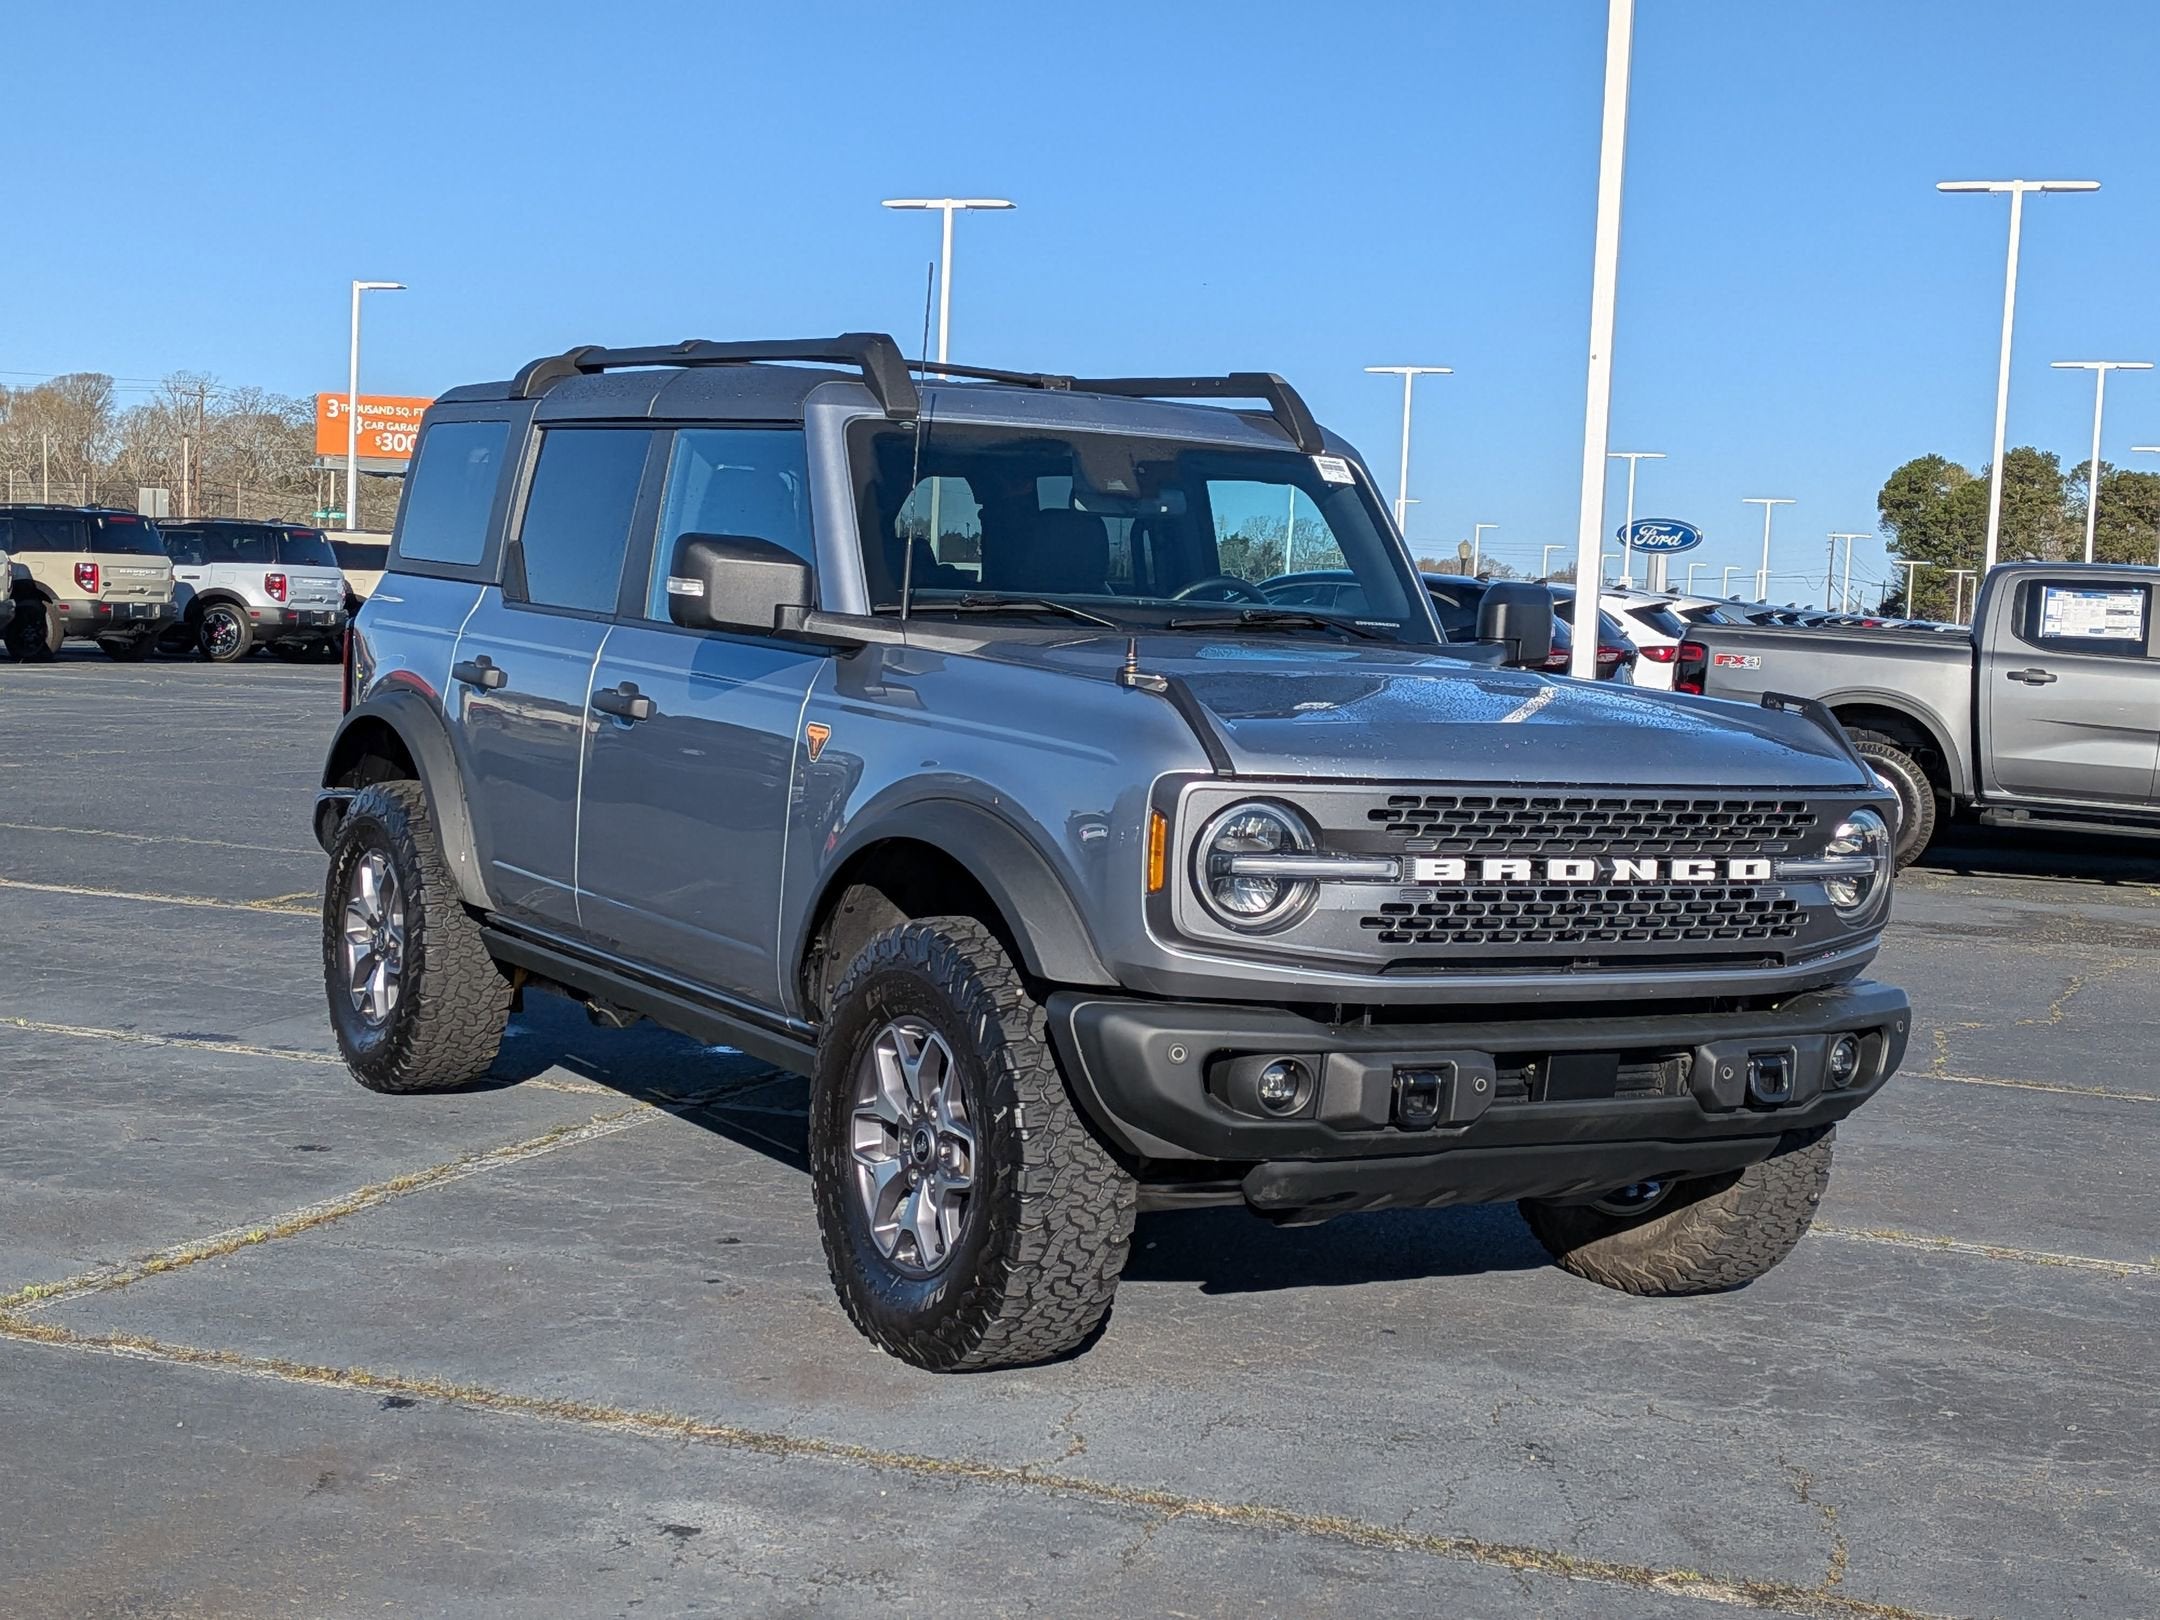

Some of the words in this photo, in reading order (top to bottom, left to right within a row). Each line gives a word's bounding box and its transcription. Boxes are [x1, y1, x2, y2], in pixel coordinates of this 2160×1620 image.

[326, 399, 339, 418] 3
[396, 404, 412, 418] SQ.
[364, 421, 385, 431] CAR
[1634, 525, 1684, 546] Ford
[1414, 858, 1771, 881] BRONCO
